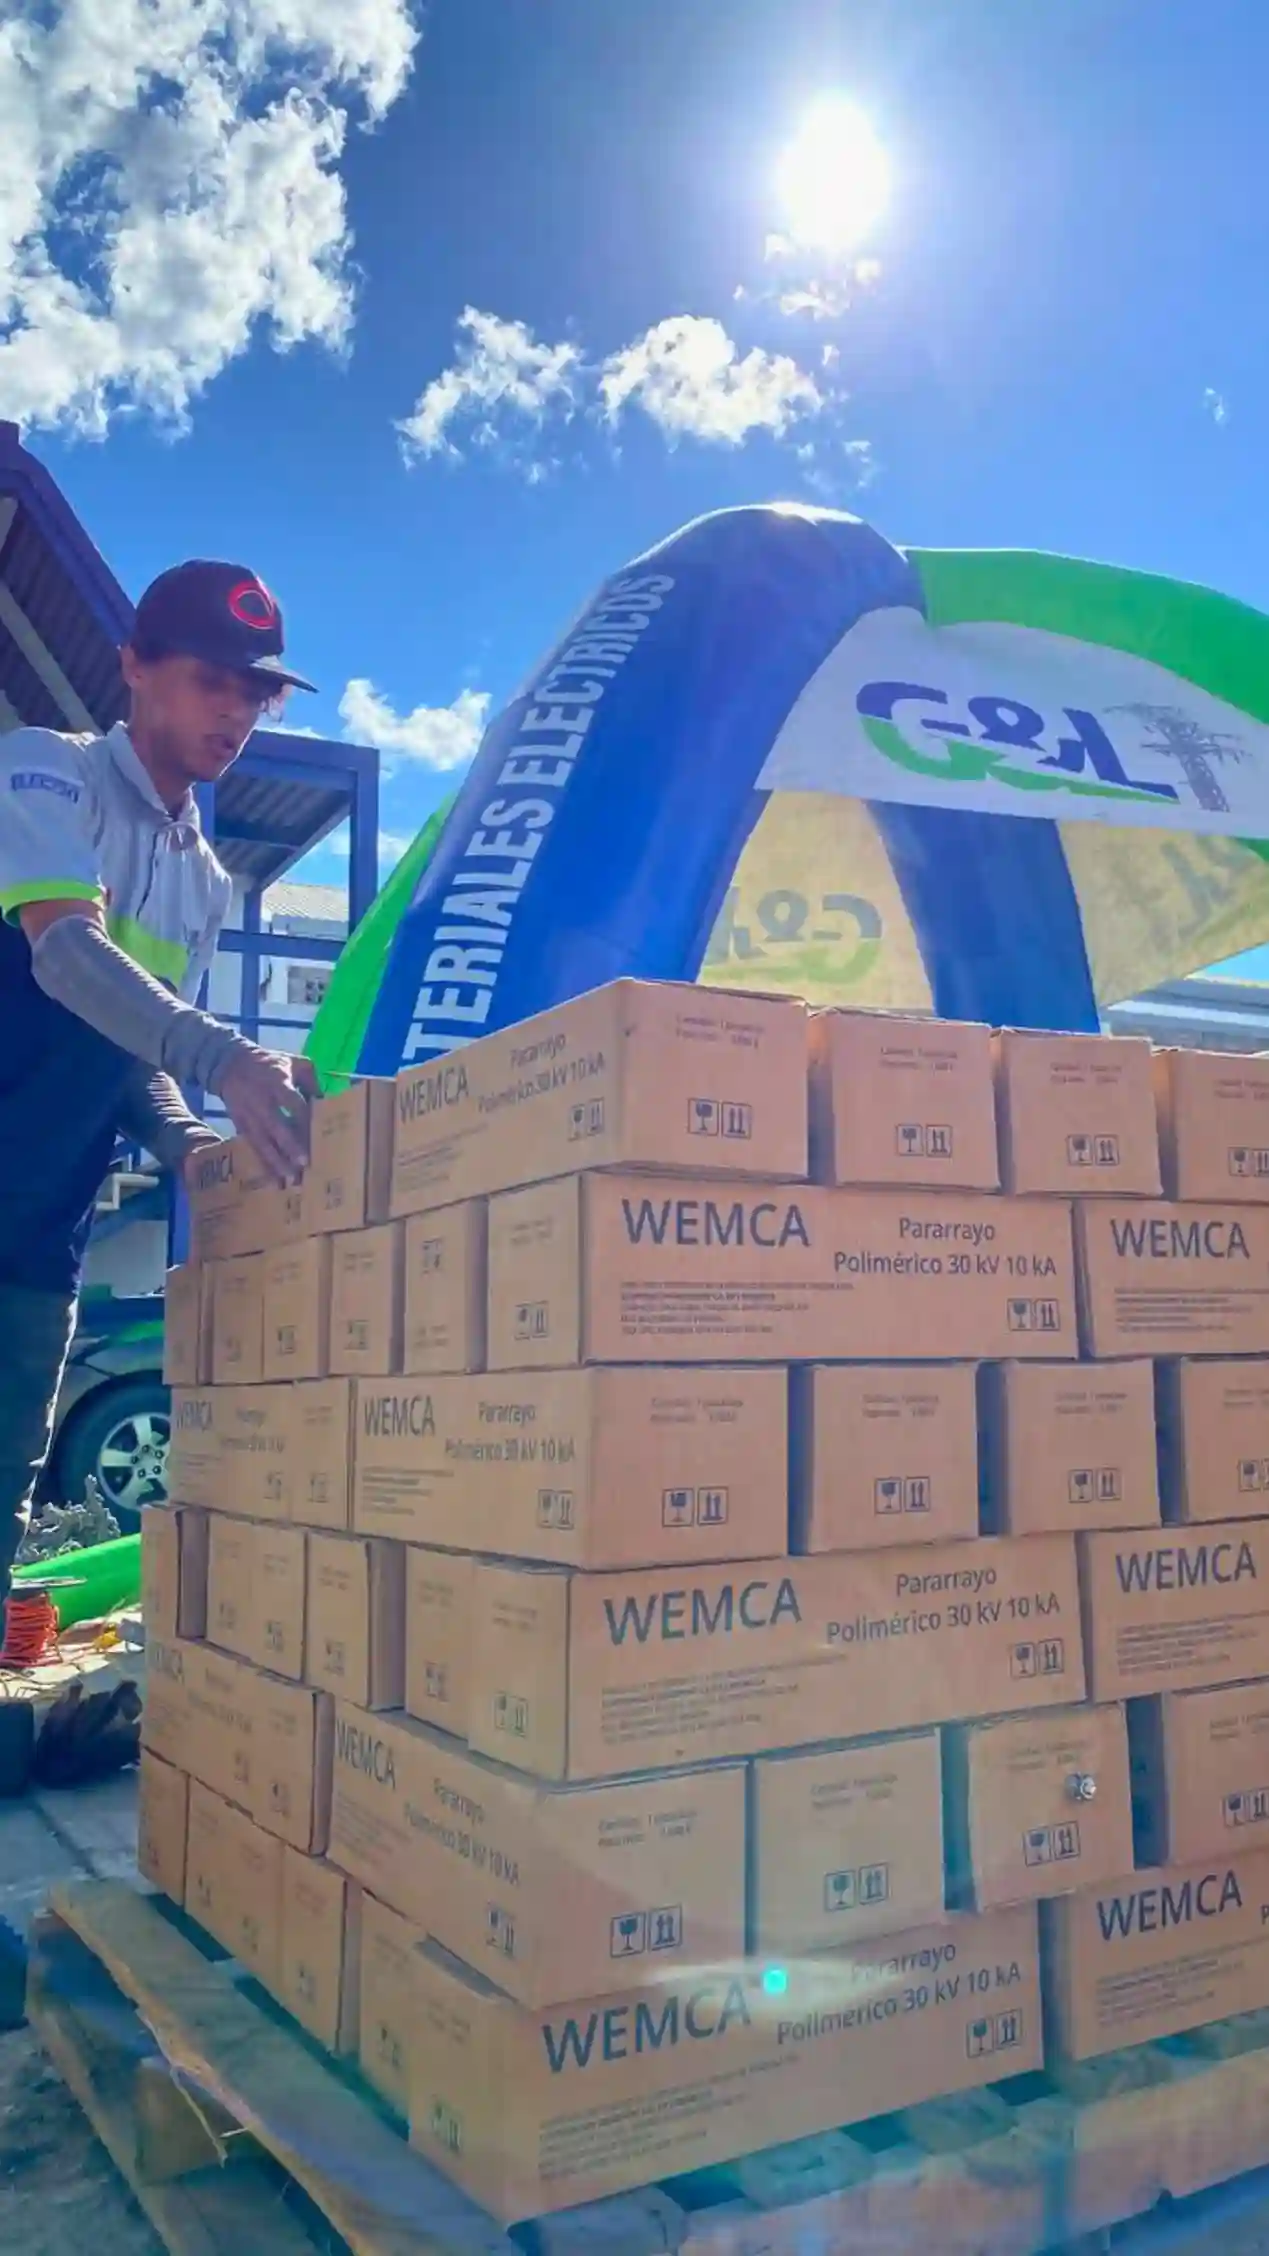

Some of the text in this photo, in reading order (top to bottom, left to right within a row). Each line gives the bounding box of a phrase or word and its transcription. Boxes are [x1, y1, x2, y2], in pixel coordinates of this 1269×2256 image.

[402, 799, 555, 1060] TERIALES
[498, 573, 676, 788] ELECTRICOS
[399, 1064, 469, 1123] WEMCA
[621, 1198, 811, 1247] WEMCA
[899, 1217, 995, 1247] Pararrayo
[1110, 1218, 1250, 1260] WEMCA
[834, 1250, 1057, 1276] Polimérico 30 kV 10 kA
[364, 1394, 435, 1437] WEMCA
[478, 1401, 537, 1428] Pararrayo
[541, 1439, 555, 1462] 10
[896, 1567, 997, 1598] Pararrayo
[1115, 1540, 1257, 1593] WEMCA
[604, 1577, 802, 1646] WEMCA
[826, 1592, 1061, 1645] Polimérico 30 kV 10 kA
[335, 1719, 396, 1791] WEMCA
[1096, 1869, 1243, 1941] WEMCA
[850, 1942, 957, 1983] Pararrayo
[902, 1988, 927, 2013] 30
[932, 1978, 960, 2007] kV
[967, 1967, 990, 1994] 10
[994, 1959, 1021, 1987] kA
[541, 1981, 751, 2074] WEMCA
